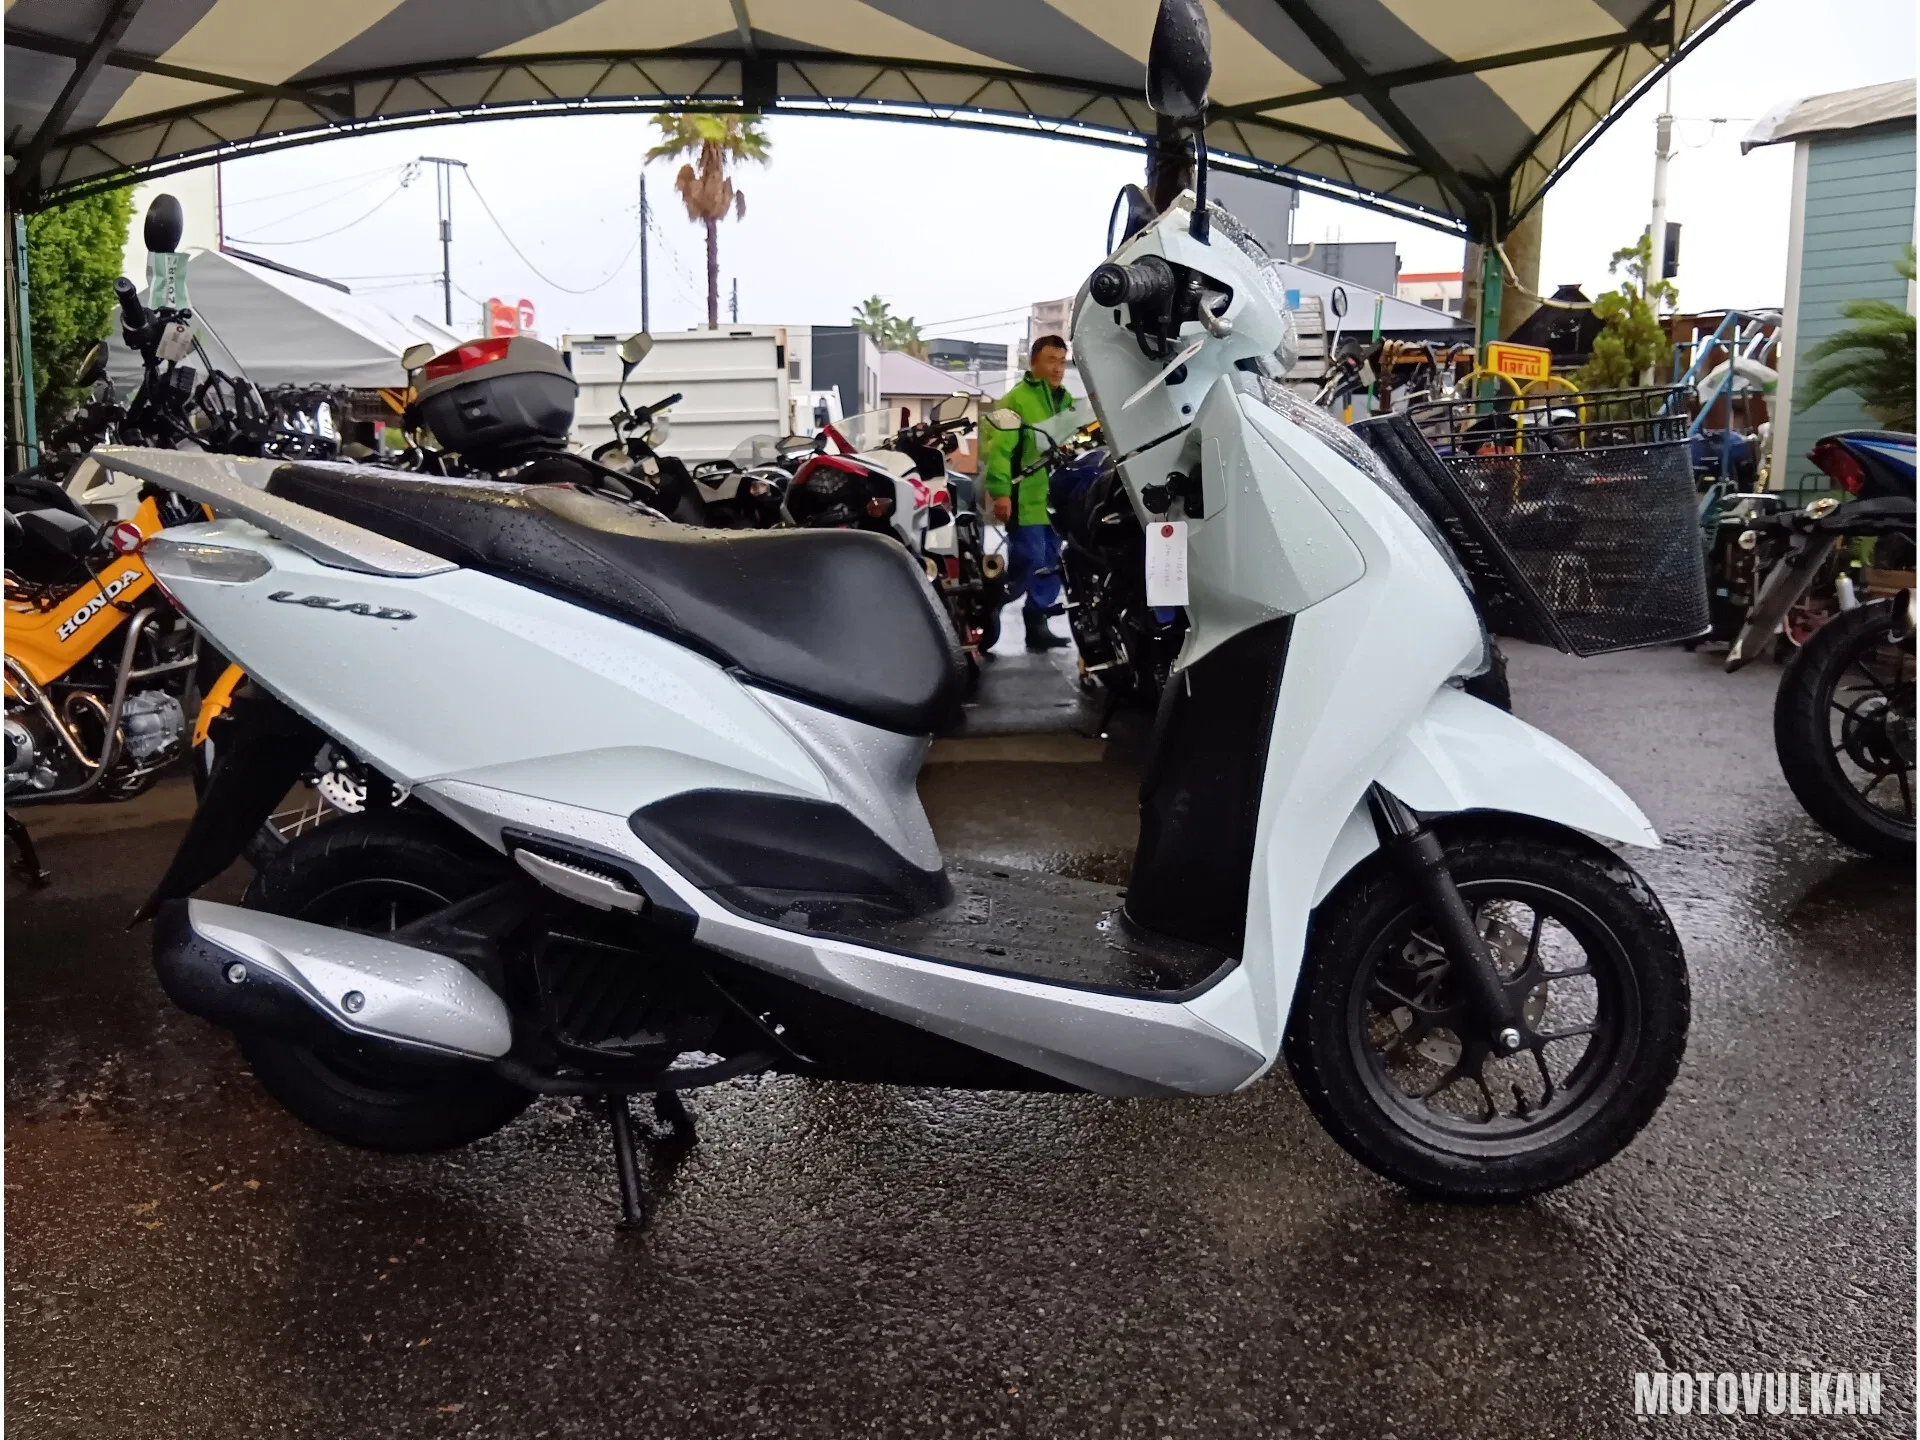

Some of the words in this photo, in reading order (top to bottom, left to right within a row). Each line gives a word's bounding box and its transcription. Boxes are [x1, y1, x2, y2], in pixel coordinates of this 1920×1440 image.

[1498, 351, 1542, 376] PIRELLI
[56, 569, 143, 642] HONDA
[267, 591, 418, 620] LEAD
